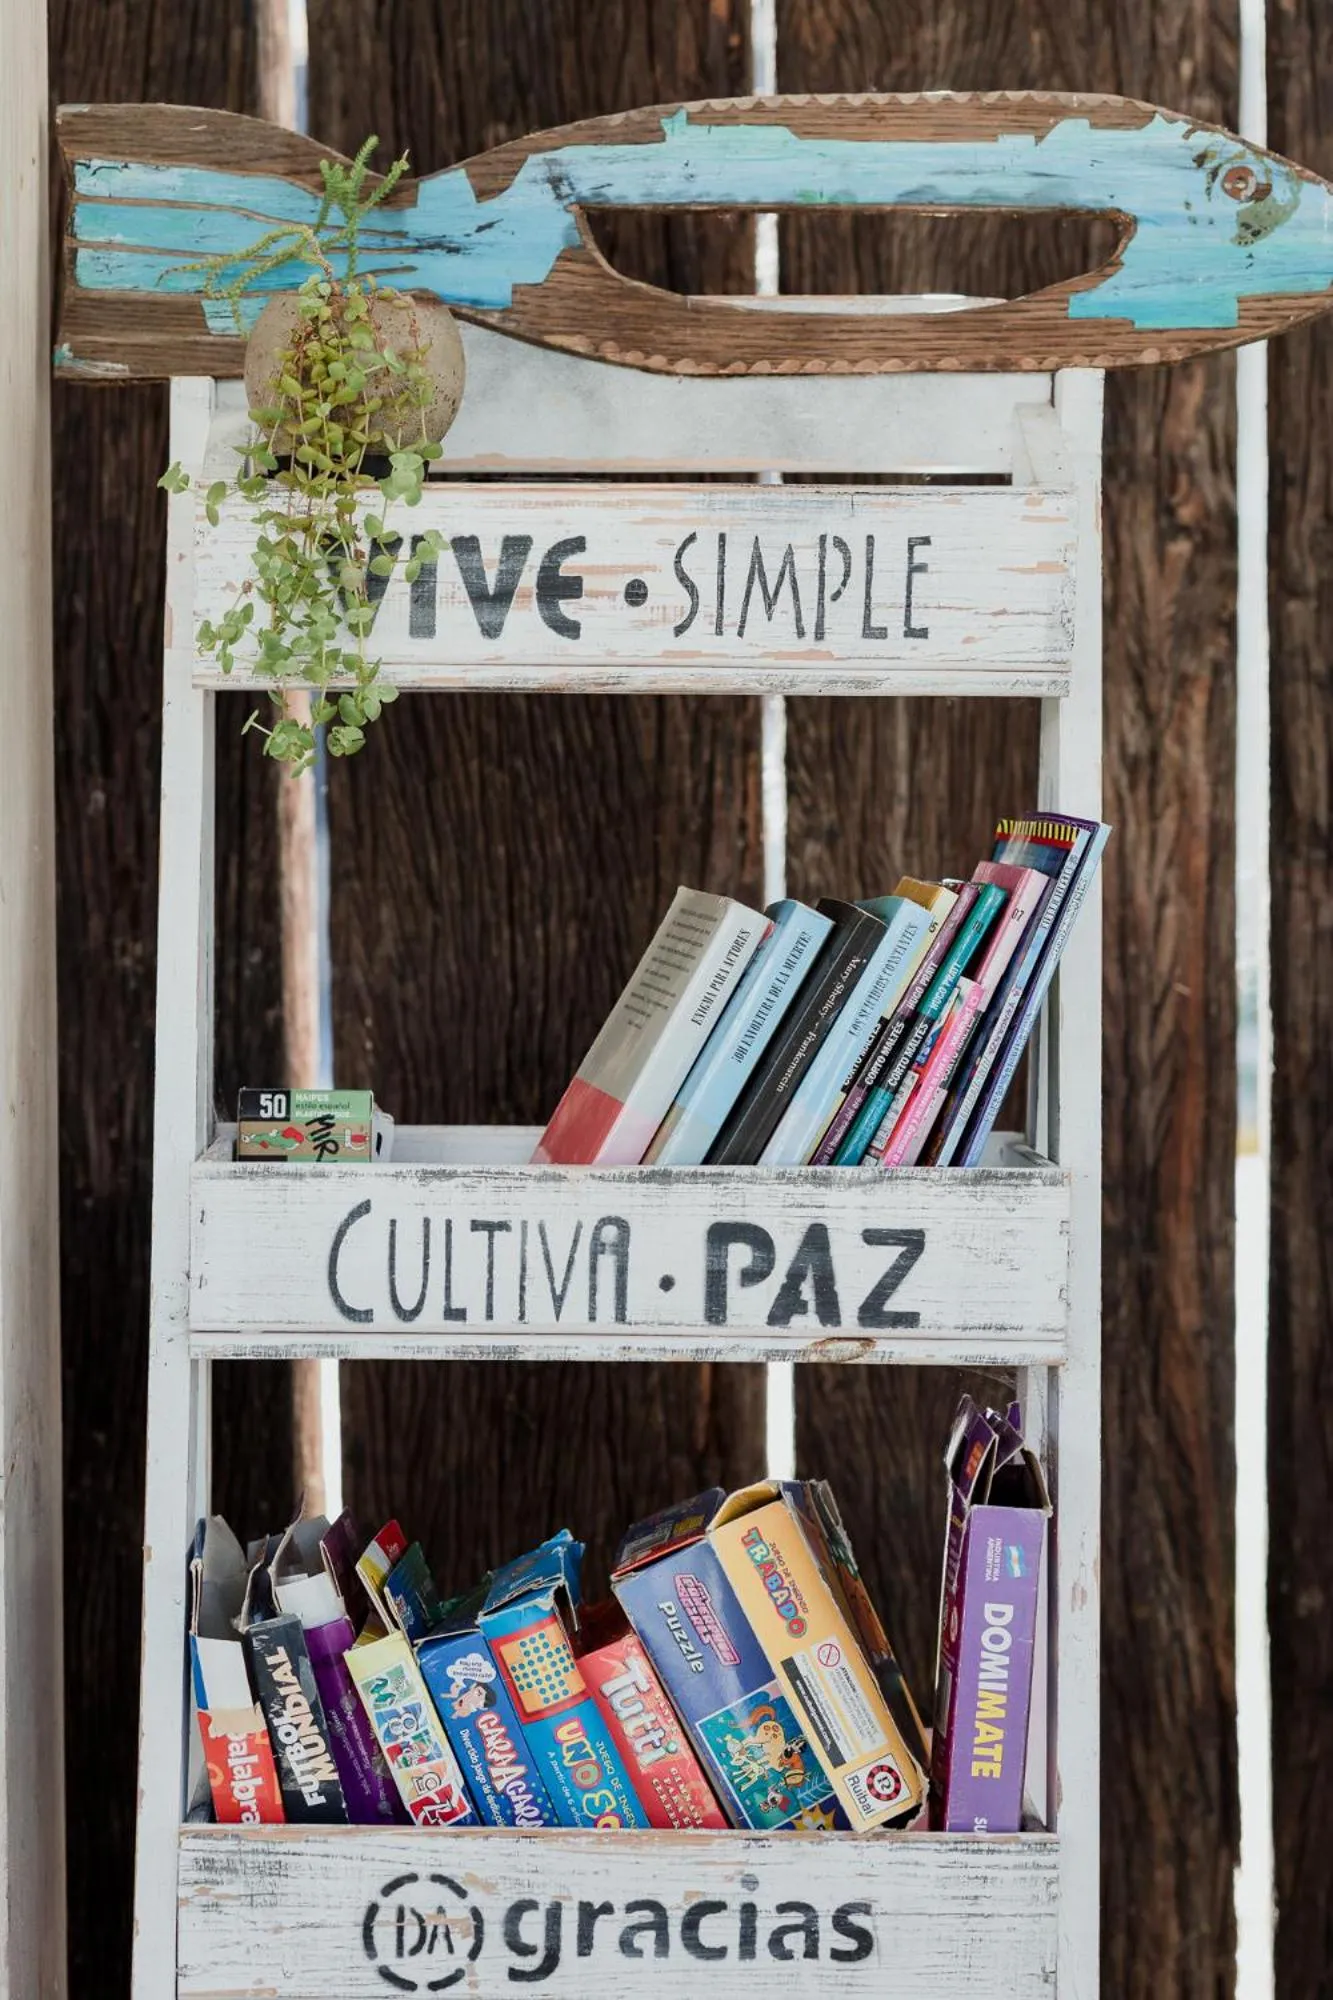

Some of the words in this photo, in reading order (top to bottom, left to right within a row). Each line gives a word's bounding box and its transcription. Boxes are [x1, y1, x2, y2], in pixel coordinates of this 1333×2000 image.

[317, 535, 586, 640] VIVE
[674, 531, 933, 641] SIMPLE
[690, 989, 717, 1026] ENIGMA
[709, 965, 730, 992] PARA
[722, 926, 751, 968] ACTORES
[767, 982, 783, 998] DE
[774, 969, 790, 984] LA
[817, 981, 846, 1020] Shelley
[838, 955, 861, 983] Mary
[847, 1017, 865, 1038] LOS
[857, 973, 889, 1021] SUICIDIOS
[881, 921, 919, 977] CONSTANTES
[740, 995, 776, 1047] ENVOLTURA
[863, 1052, 887, 1086] CORTO
[880, 1018, 905, 1057] MALTÉS
[906, 985, 924, 1010] HUGO
[919, 960, 938, 987] PRATT
[886, 1054, 910, 1087] CORTO
[902, 1019, 928, 1058] MALTÉS
[929, 984, 948, 1010] HUGO
[941, 959, 960, 986] PRATT
[774, 1030, 817, 1094] Frankenstein
[259, 1094, 287, 1118] 50
[305, 1113, 340, 1162] MIR
[327, 1198, 631, 1323] CULTIVA
[705, 1222, 927, 1329] PAZ
[741, 1525, 808, 1638] TRABADO
[657, 1600, 704, 1674] Puzzle
[265, 1646, 339, 1780] MUNDIAL
[600, 1655, 678, 1772] Tutti
[970, 1601, 1014, 1779] DOMIMATE
[272, 1711, 327, 1806] FUTBOL
[458, 1726, 481, 1765] Divertido
[472, 1762, 487, 1786] juego
[481, 1782, 492, 1794] de
[546, 1749, 556, 1759] A
[548, 1758, 566, 1784] partir
[555, 1718, 602, 1788] UNO
[594, 1739, 615, 1775] JUEGO
[609, 1776, 622, 1792] DE
[561, 1784, 571, 1798] de
[847, 1774, 876, 1816] Ruibal
[502, 1872, 877, 1982] gracias
